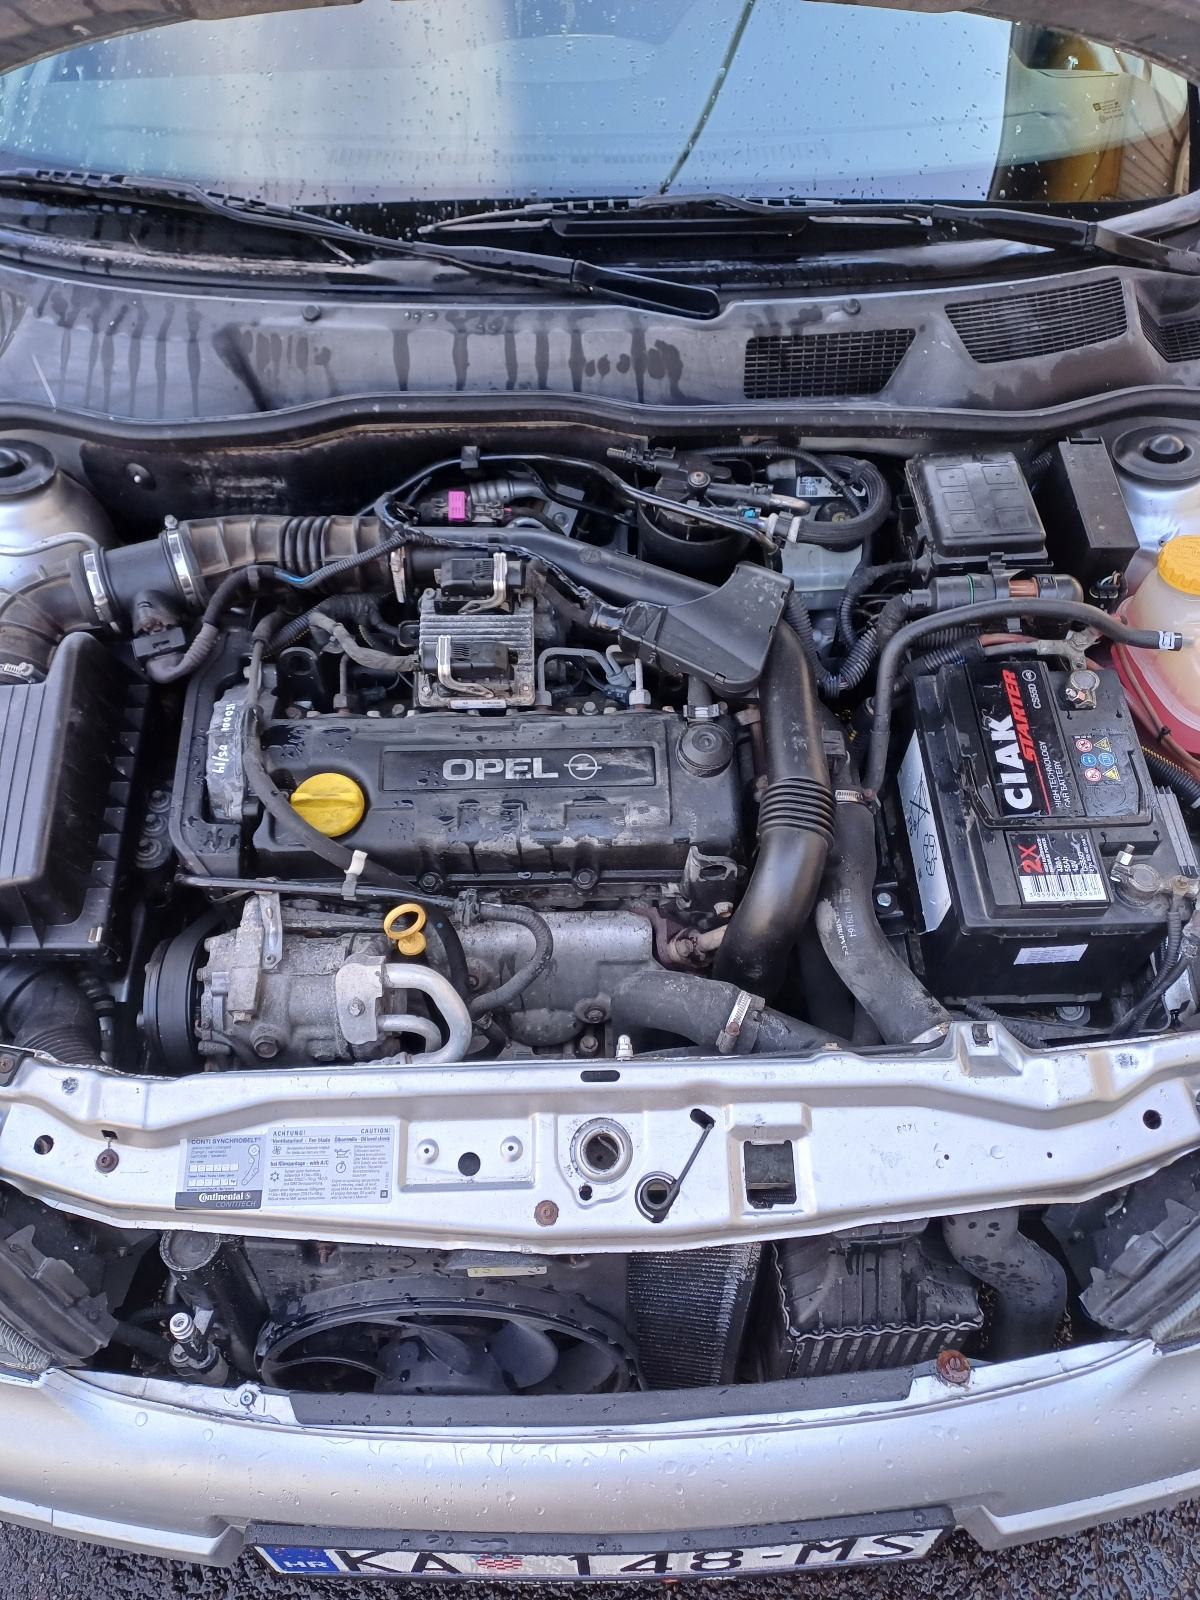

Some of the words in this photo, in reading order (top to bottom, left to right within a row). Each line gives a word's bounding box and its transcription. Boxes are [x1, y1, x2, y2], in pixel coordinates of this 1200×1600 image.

[1027, 683, 1042, 709] CS55D
[1002, 669, 1036, 763] STARTER
[442, 757, 559, 781] OPEL
[988, 714, 1033, 810] CIAK
[1039, 741, 1058, 789] TECHNOLOGY
[1053, 760, 1068, 791] BATTERY
[1017, 843, 1044, 874] 2X
[272, 1129, 306, 1137] ACHTUNG!
[198, 1191, 244, 1203] Continental
[215, 1200, 257, 1208] CONTITECH
[283, 1560, 329, 1569] HR
[334, 1549, 463, 1574] KA
[568, 1530, 926, 1576] 148-MS
